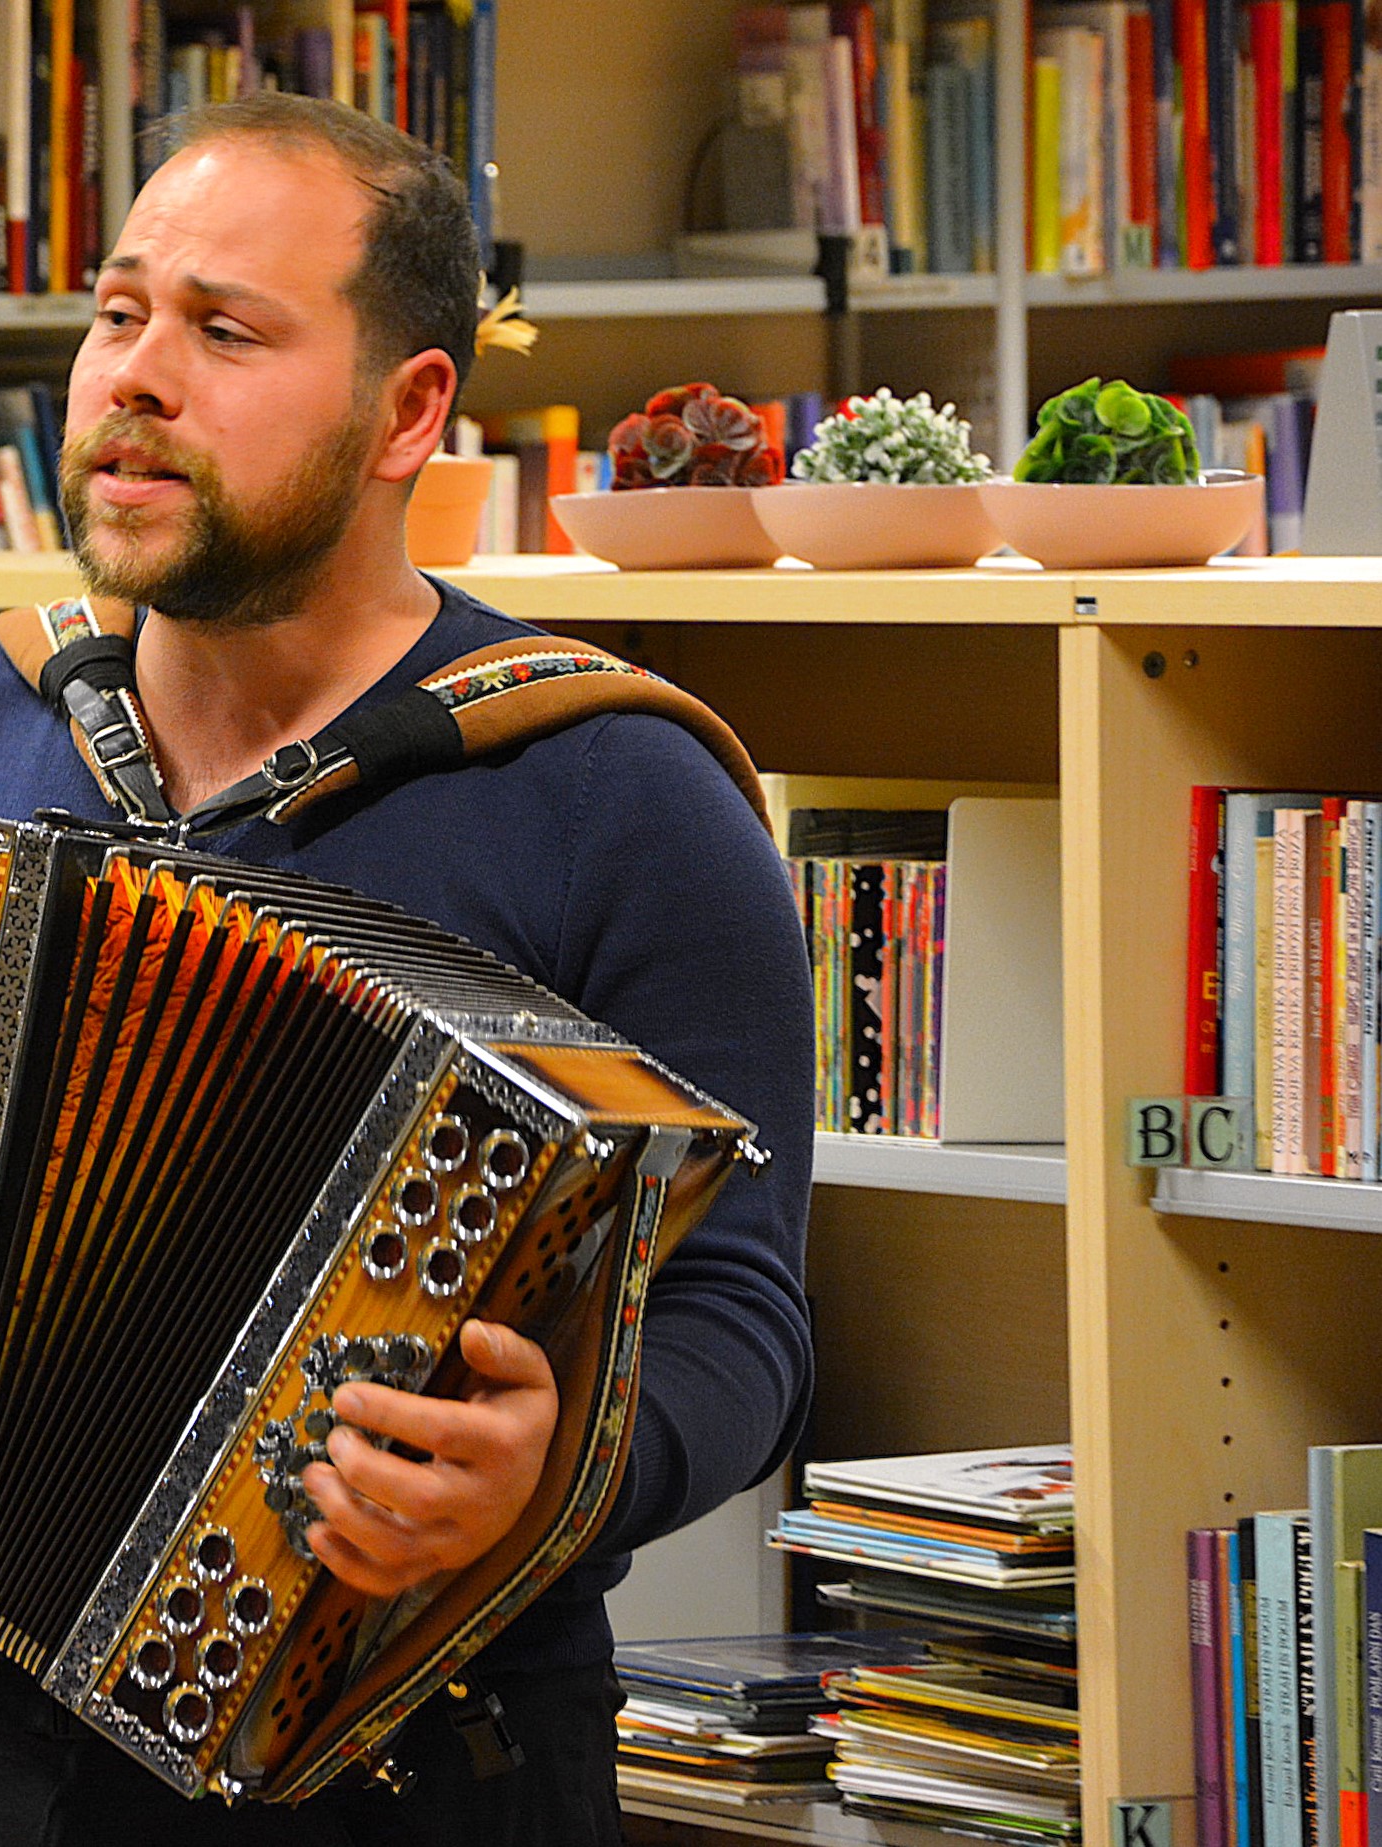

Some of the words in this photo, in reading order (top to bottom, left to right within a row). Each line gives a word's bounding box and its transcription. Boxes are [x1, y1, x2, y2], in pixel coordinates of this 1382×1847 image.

[1273, 828, 1288, 880] PROZA
[1289, 829, 1302, 880] PROZA
[1273, 883, 1287, 980] PRIPOVEDNA
[1288, 884, 1302, 982] PRIPOVEDNA
[1272, 985, 1287, 1048] KRATKA
[1288, 987, 1301, 1050] KRATKA
[1137, 1104, 1176, 1160] B
[1272, 1053, 1287, 1155] CANKARJEVA
[1288, 1054, 1301, 1156] CANKARJEVA
[1198, 1105, 1234, 1163] C
[1259, 1597, 1273, 1647] POGUM
[1276, 1599, 1290, 1651] POGUM
[1368, 1610, 1382, 1639] DAN
[1261, 1667, 1274, 1712] STRAH
[1279, 1669, 1292, 1716] STRAH
[1368, 1641, 1382, 1709] POMLADNI
[1117, 1804, 1160, 1847] K
